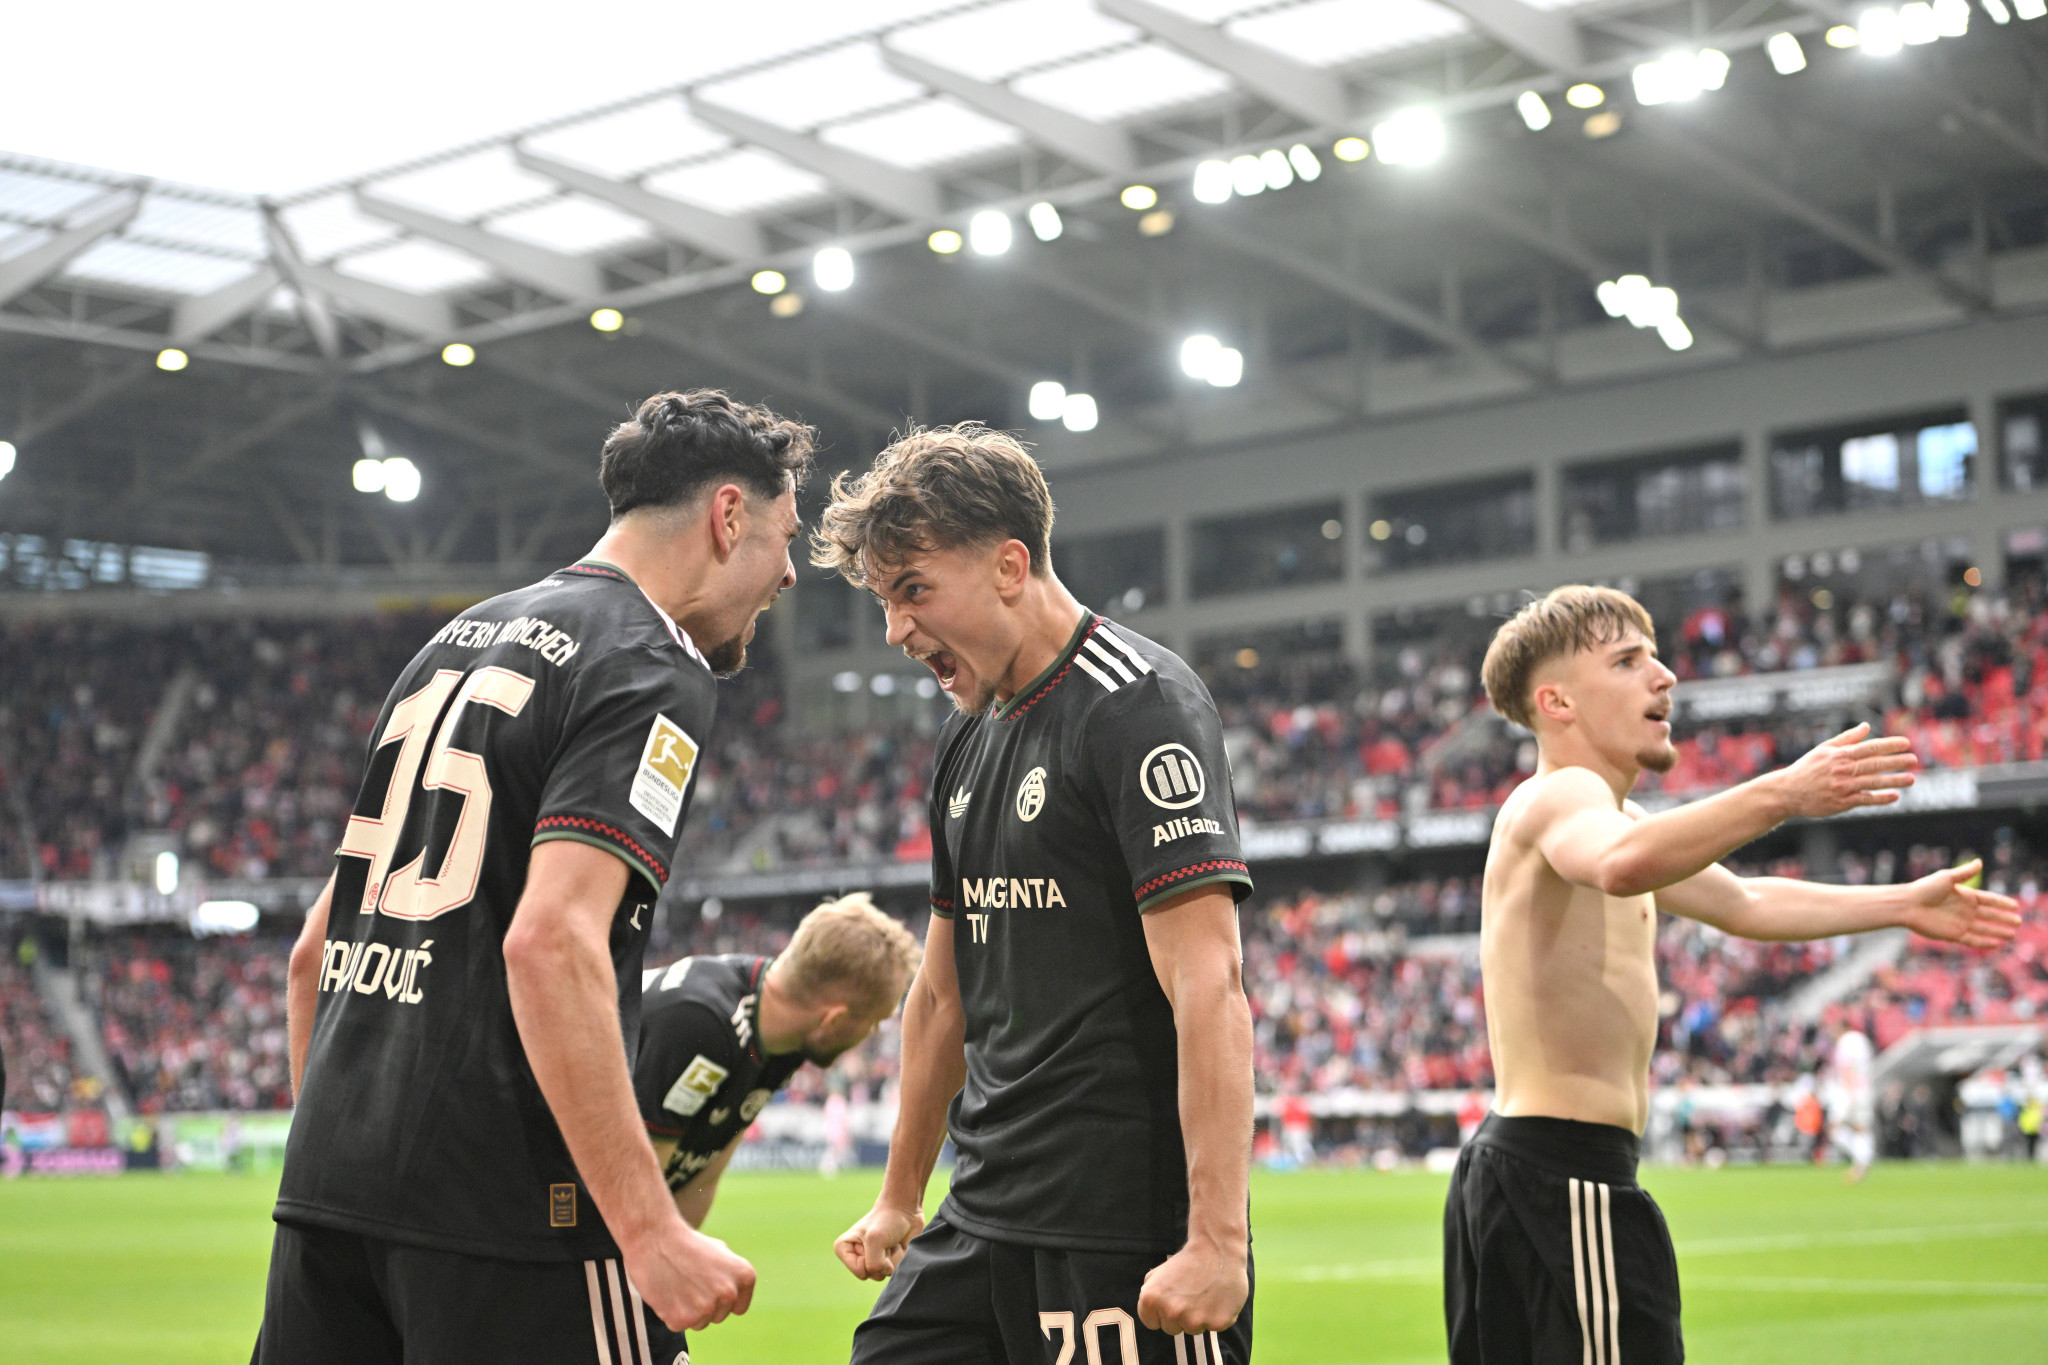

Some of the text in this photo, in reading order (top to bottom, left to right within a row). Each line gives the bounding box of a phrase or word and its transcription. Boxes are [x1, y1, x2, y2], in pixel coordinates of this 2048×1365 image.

[340, 666, 536, 921] 45
[642, 768, 679, 802] BUNDESLIGA
[1152, 816, 1225, 847] Allianz
[966, 913, 989, 944] TV
